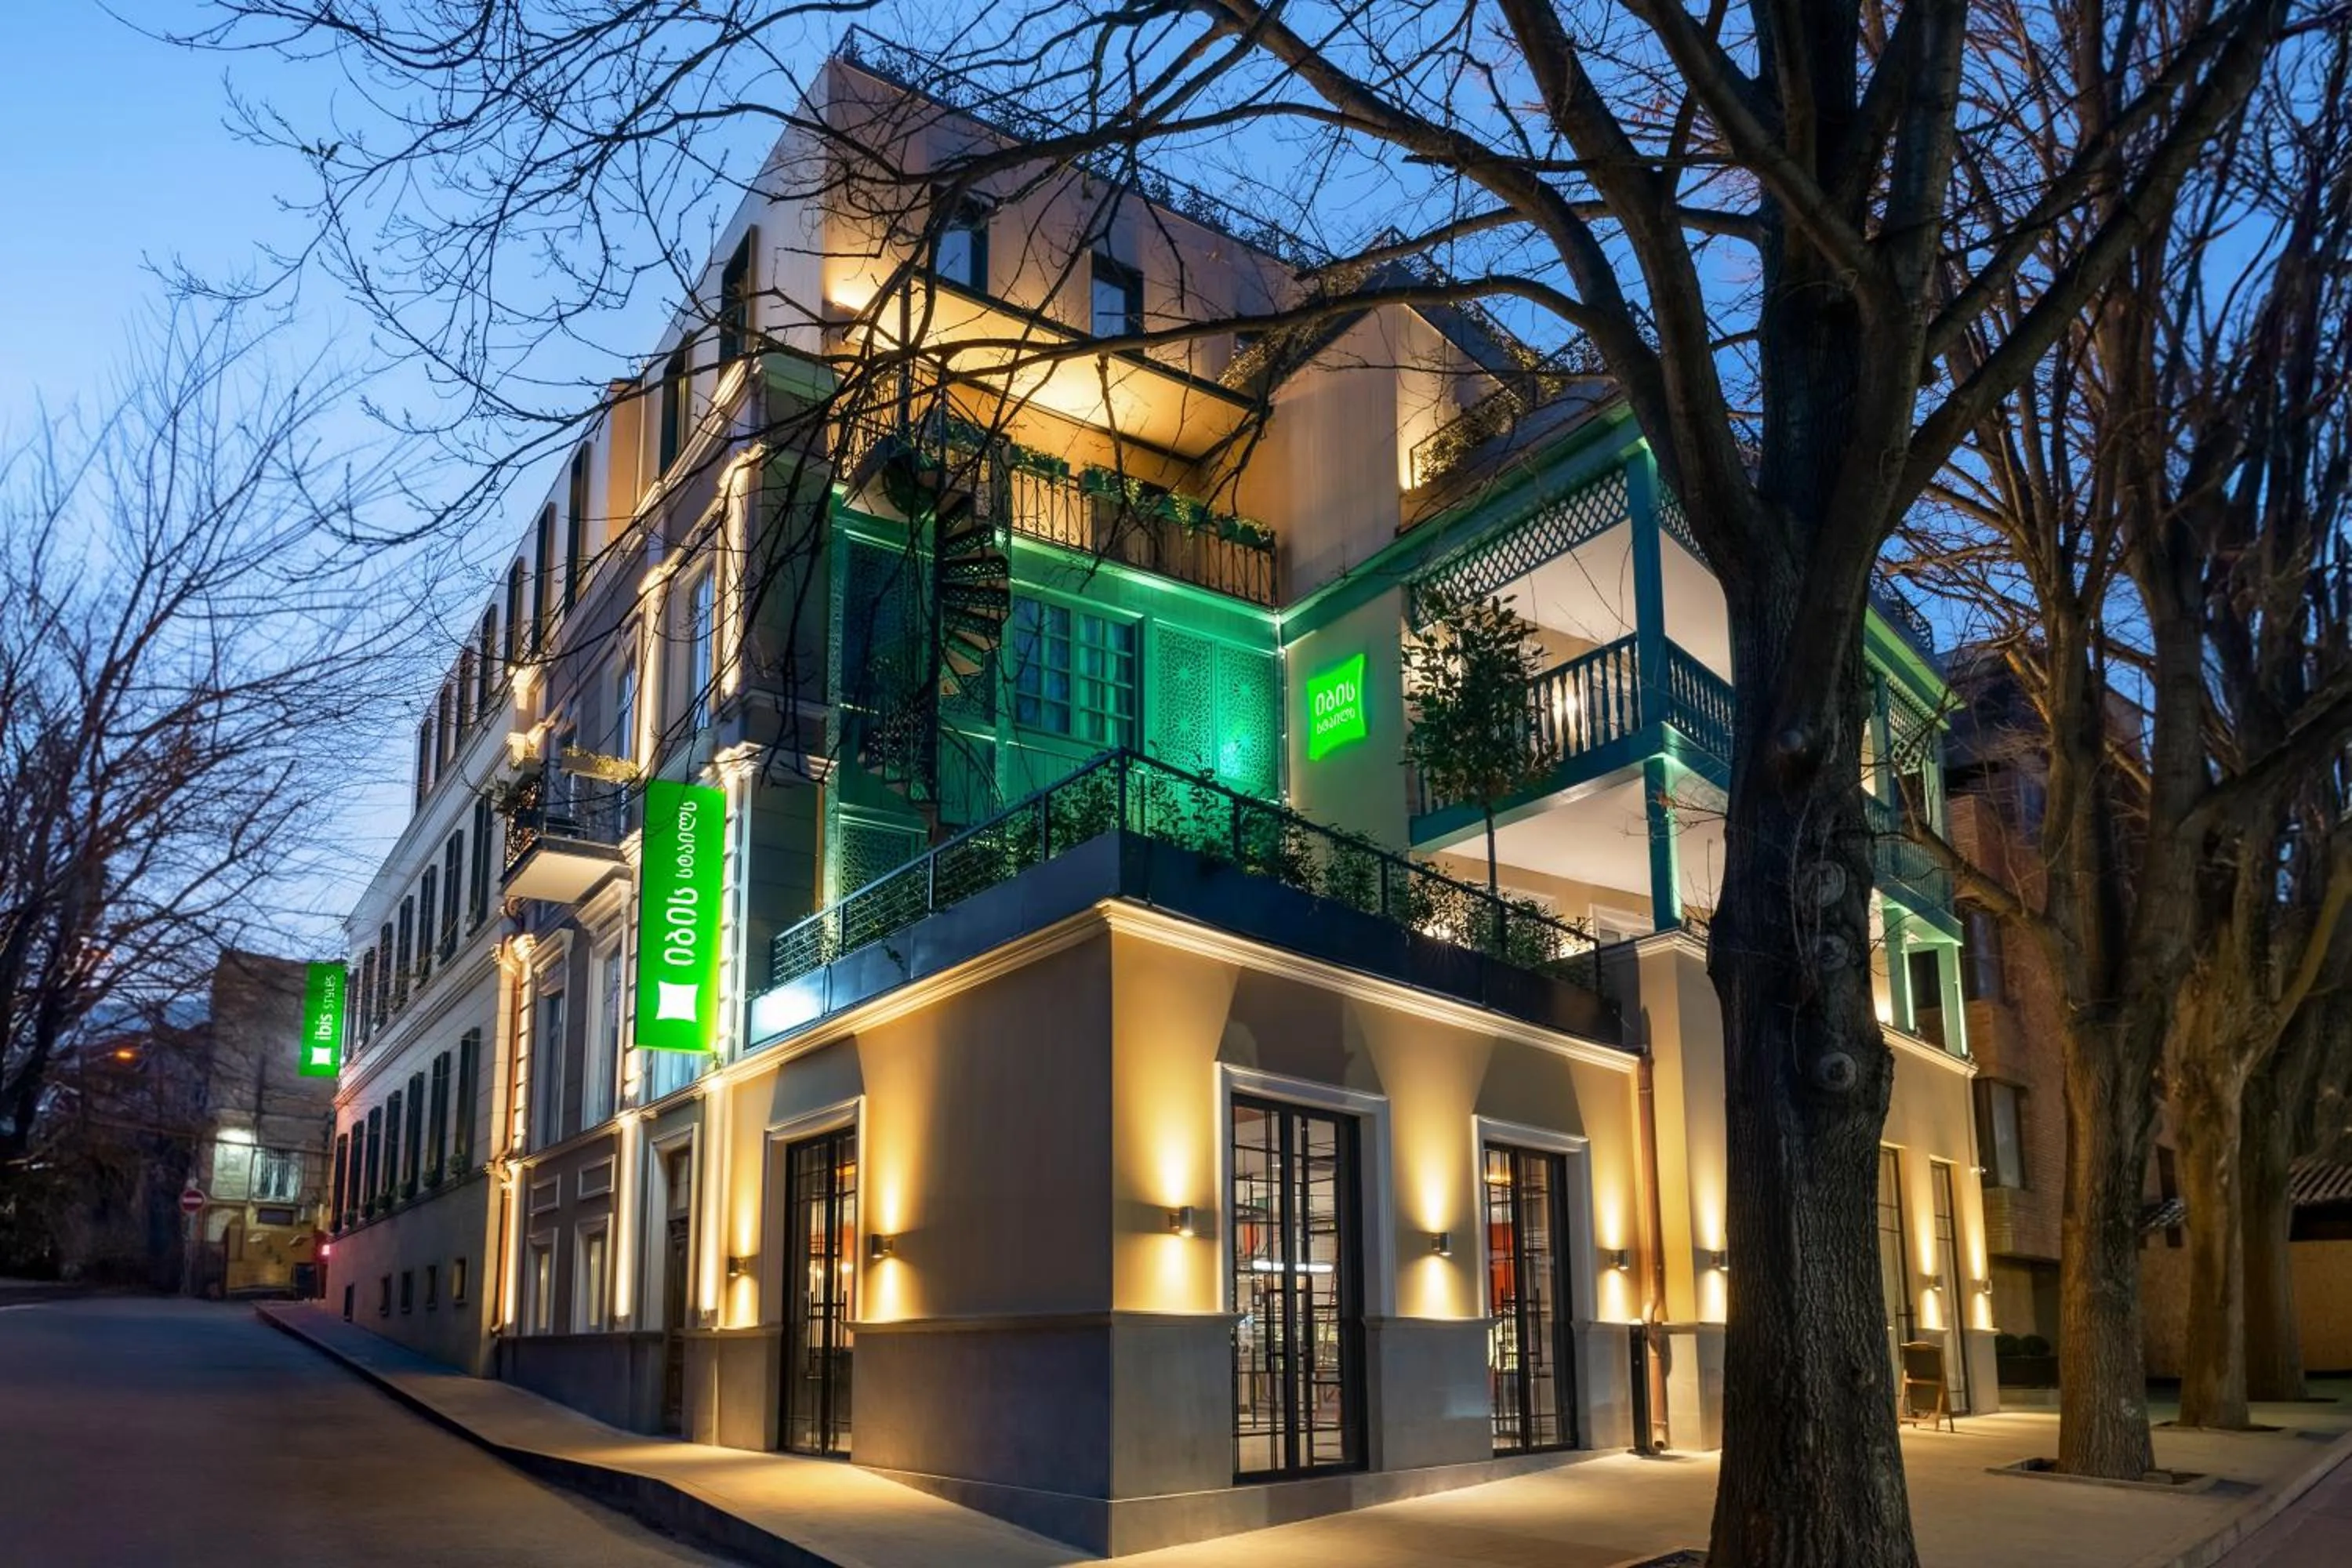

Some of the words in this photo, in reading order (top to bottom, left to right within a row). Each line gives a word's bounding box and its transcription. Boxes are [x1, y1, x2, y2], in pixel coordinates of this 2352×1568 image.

[1315, 680, 1356, 717] იბის
[675, 800, 698, 879] სტაილს
[663, 887, 699, 967] იბის
[314, 1012, 333, 1041] ibis
